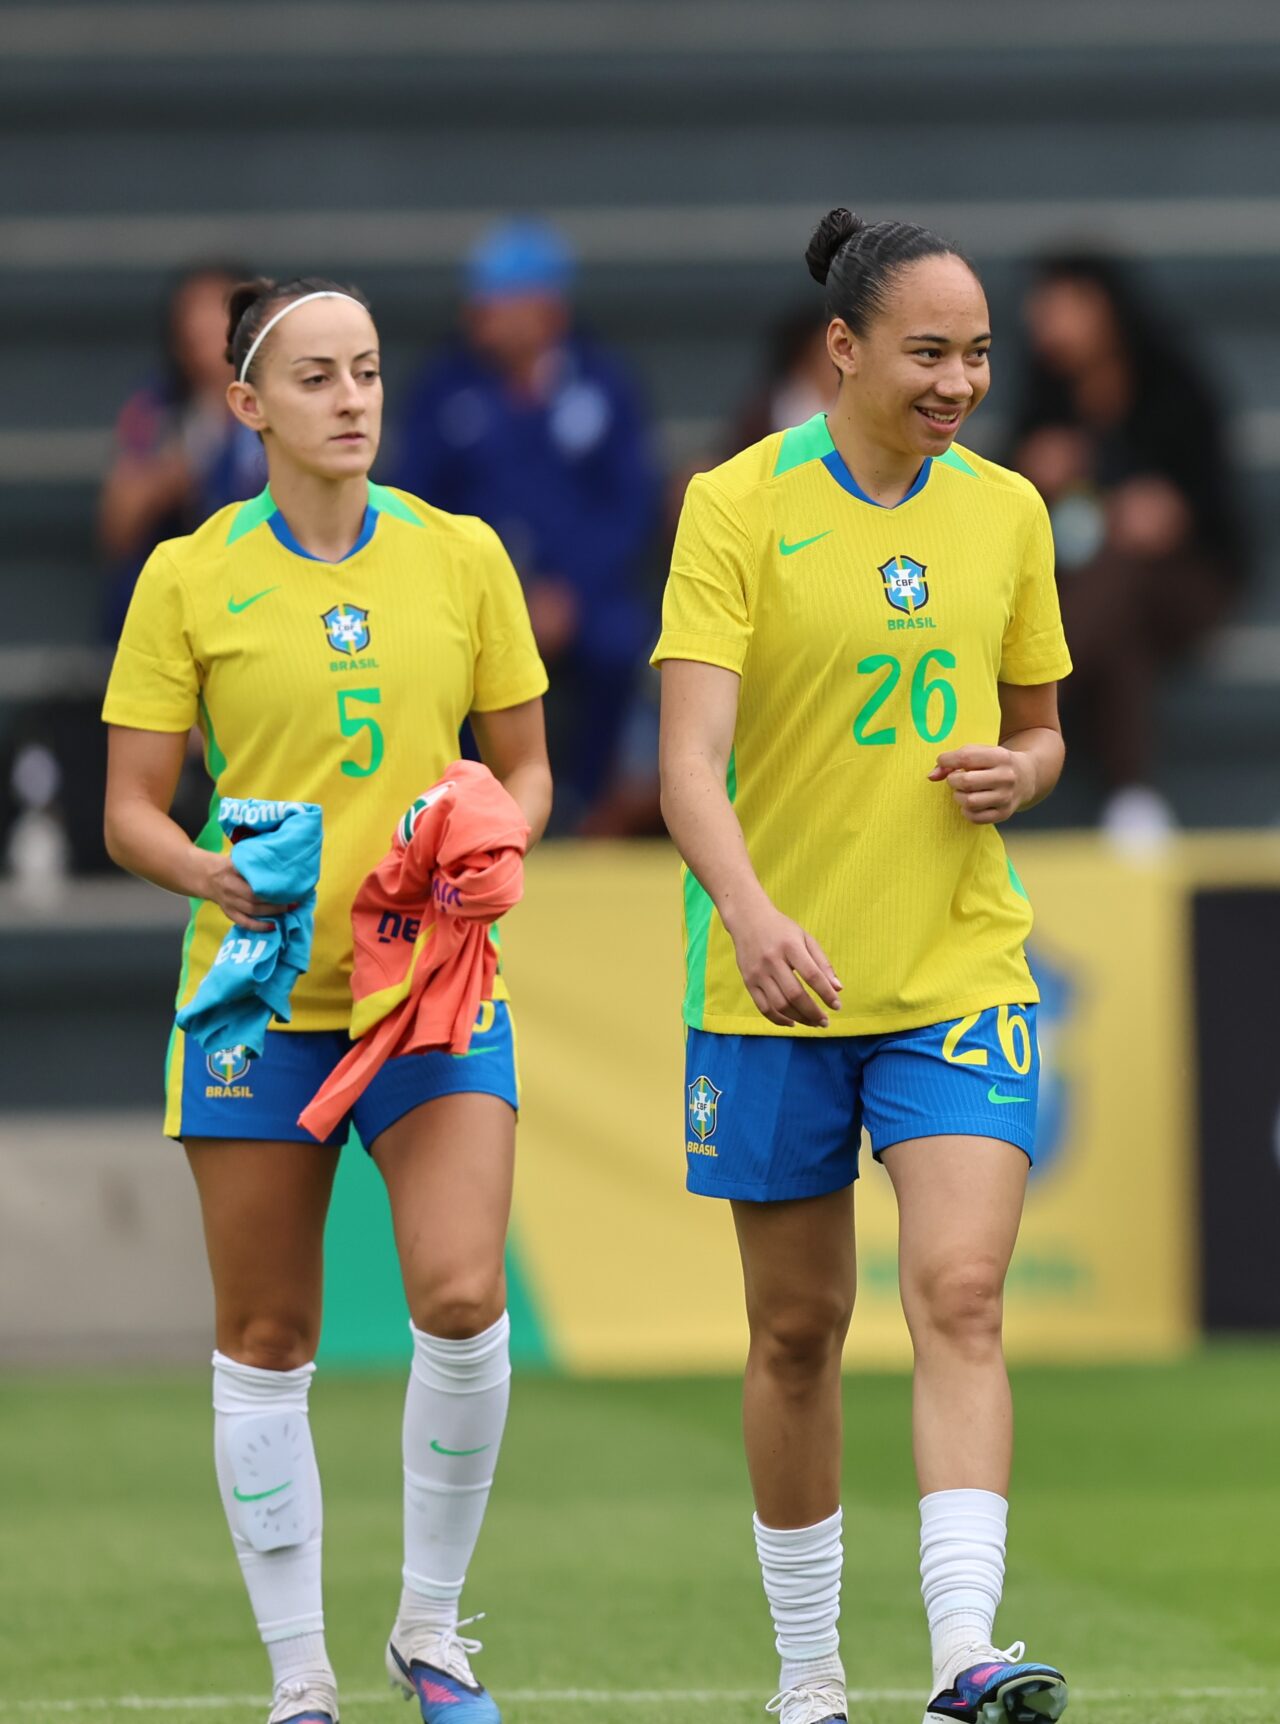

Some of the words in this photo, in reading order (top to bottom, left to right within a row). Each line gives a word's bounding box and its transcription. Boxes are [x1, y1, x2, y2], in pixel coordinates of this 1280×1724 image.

[895, 578, 914, 587] CBF
[887, 617, 937, 631] BRASIL
[329, 658, 380, 672] BRASIL
[853, 648, 957, 746] 26
[337, 687, 385, 778] 5
[942, 1004, 1032, 1075] 26
[205, 1085, 254, 1099] BRASIL
[696, 1102, 708, 1111] CBF
[687, 1141, 719, 1157] BRASIL
